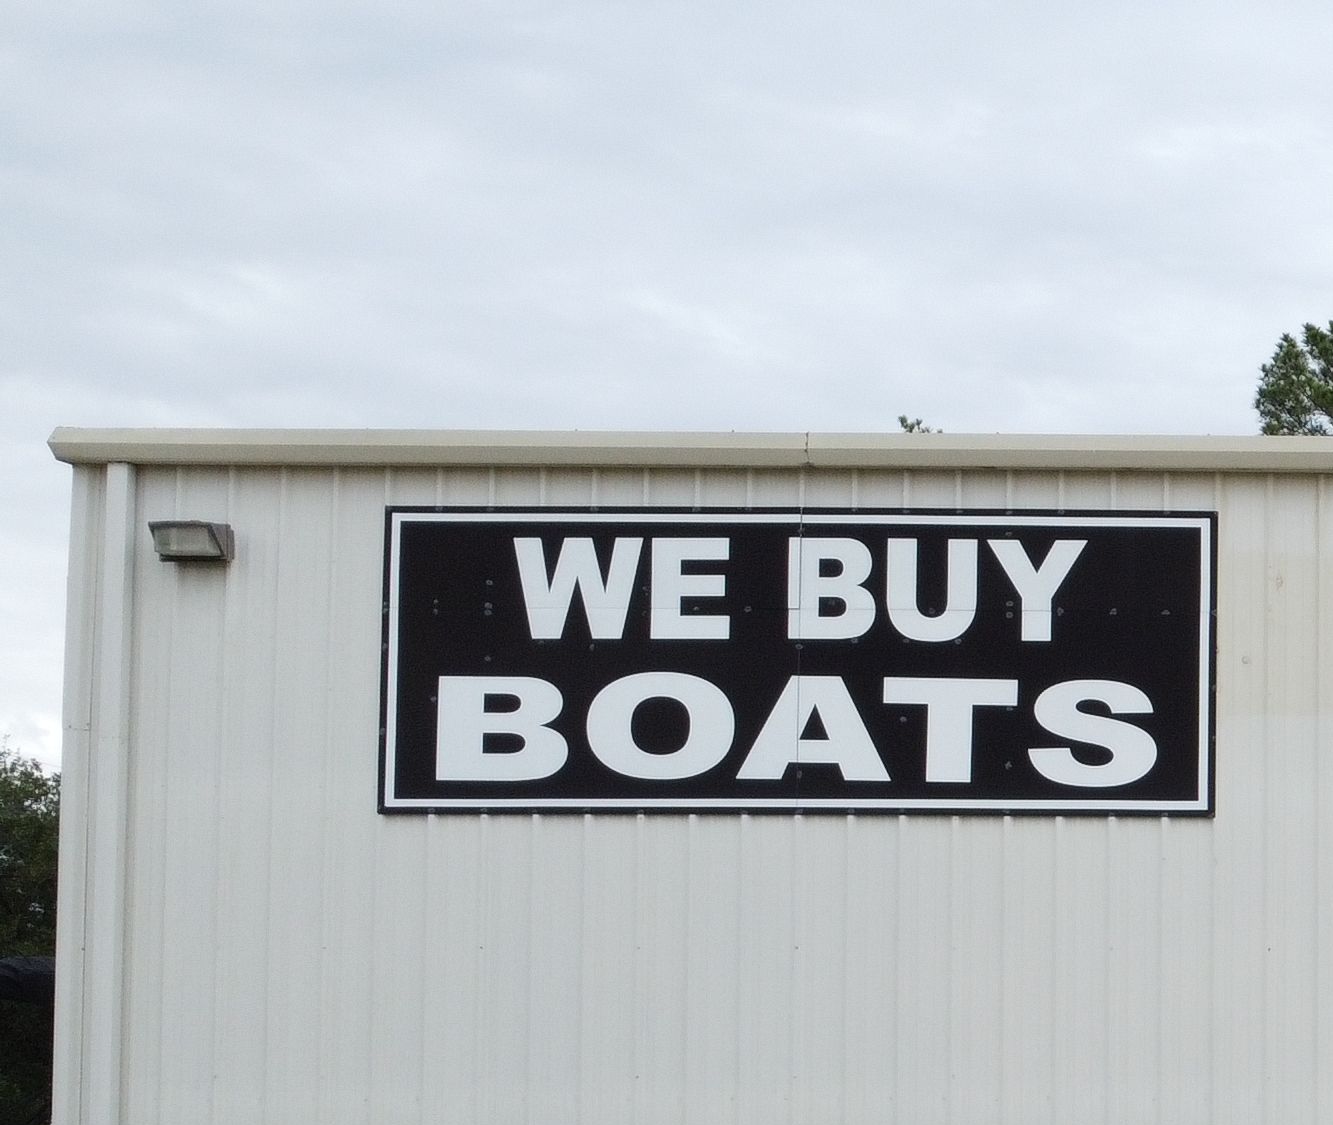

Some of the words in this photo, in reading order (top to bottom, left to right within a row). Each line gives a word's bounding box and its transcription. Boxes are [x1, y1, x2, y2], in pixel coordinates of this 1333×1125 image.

[514, 537, 731, 640] WE
[787, 536, 1088, 643] BUY
[435, 671, 1158, 788] BOATS
